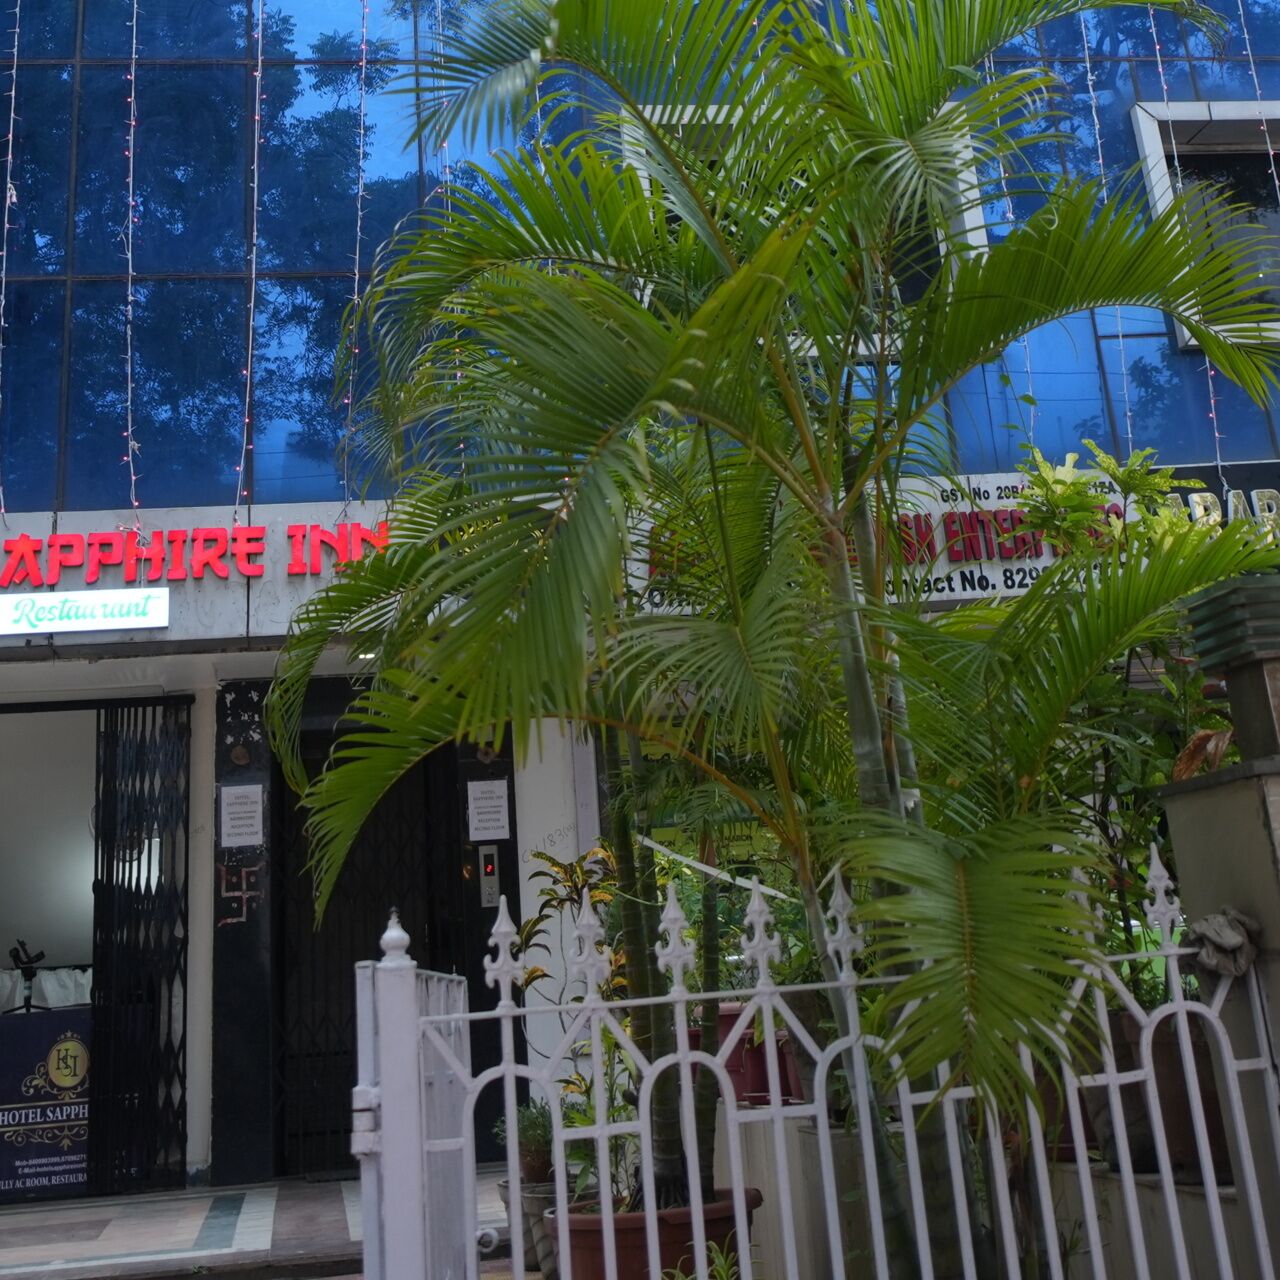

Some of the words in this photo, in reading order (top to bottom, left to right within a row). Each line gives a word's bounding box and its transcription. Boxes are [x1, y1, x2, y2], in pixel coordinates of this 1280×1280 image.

[286, 520, 391, 576] INN
[959, 570, 997, 592] No.
[11, 592, 159, 627] Restaurant
[46, 1103, 89, 1122] SAPPH
[14, 1178, 25, 1189] AC
[25, 1175, 50, 1188] ROOM,
